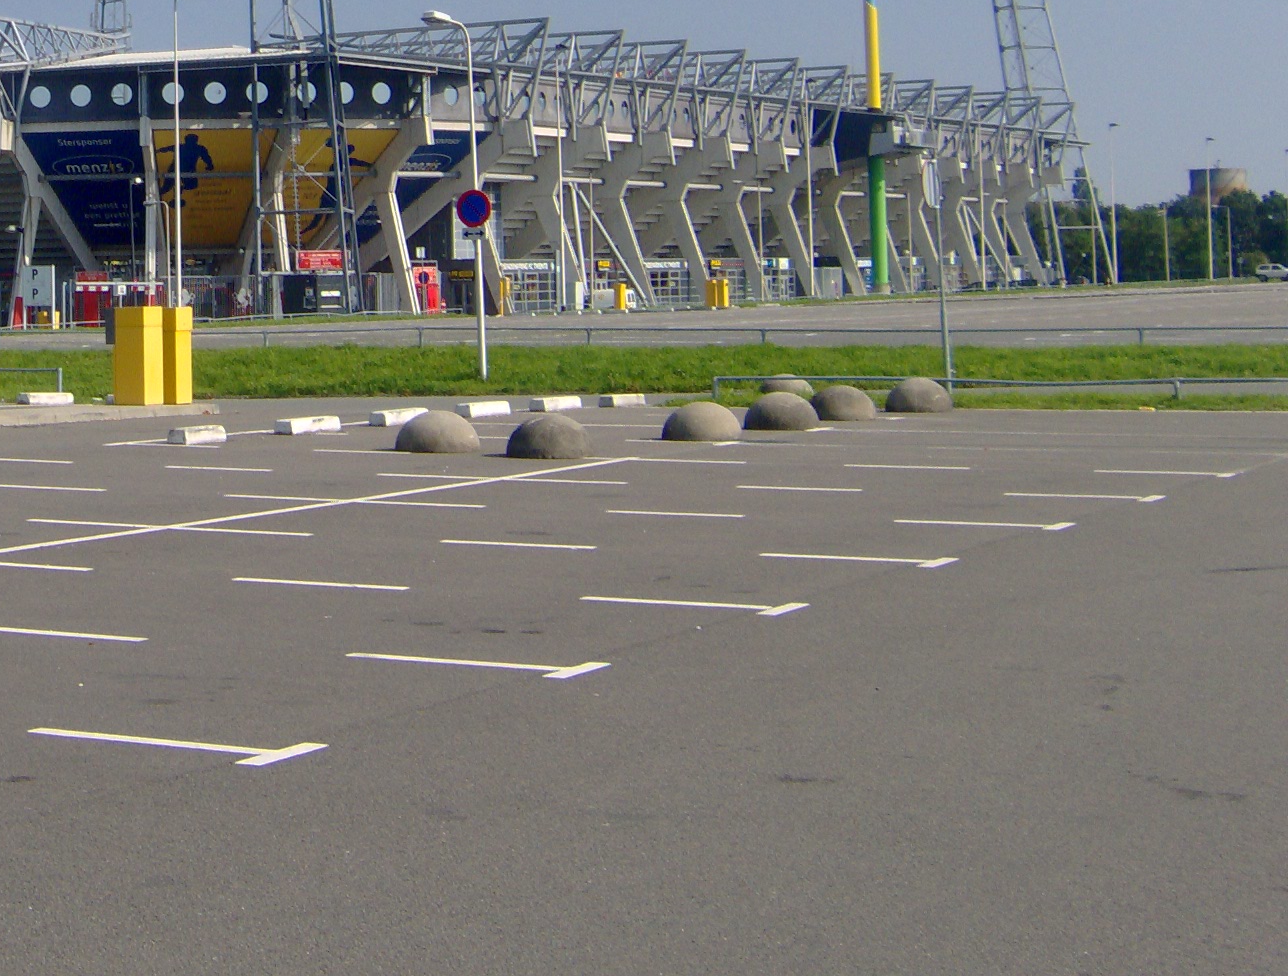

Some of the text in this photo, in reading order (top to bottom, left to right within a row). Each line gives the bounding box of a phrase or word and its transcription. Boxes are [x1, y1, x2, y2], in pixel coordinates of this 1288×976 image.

[57, 138, 112, 147] Stersponsor
[65, 160, 124, 173] menzis
[31, 268, 38, 280] P
[32, 287, 39, 300] P
